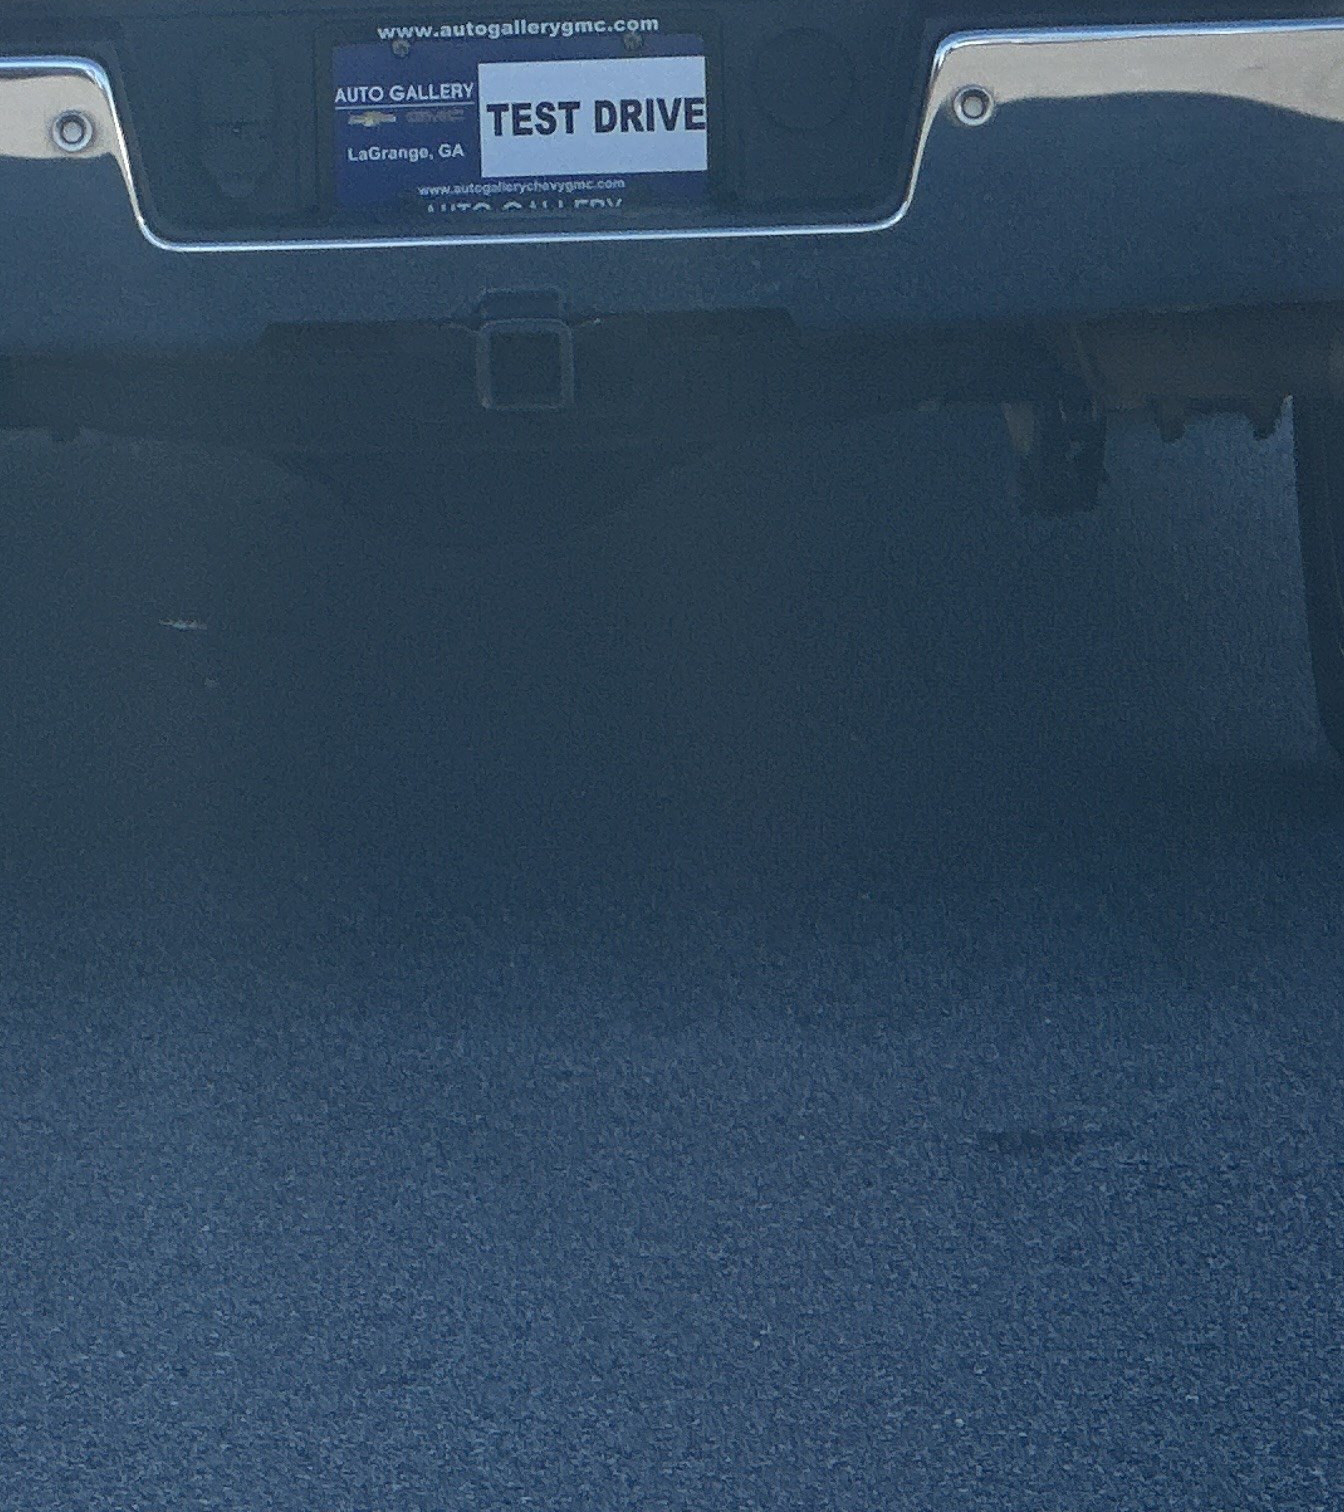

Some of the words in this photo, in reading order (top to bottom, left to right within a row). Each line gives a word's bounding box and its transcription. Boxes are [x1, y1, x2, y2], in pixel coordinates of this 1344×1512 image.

[377, 17, 660, 40] www.autogallerygmc.com
[334, 86, 384, 104] AUTO
[388, 82, 475, 102] GALLERY
[486, 101, 581, 137] TEST
[593, 97, 707, 134] DRIVE
[347, 146, 434, 163] LaGrange,
[438, 143, 465, 159] GA
